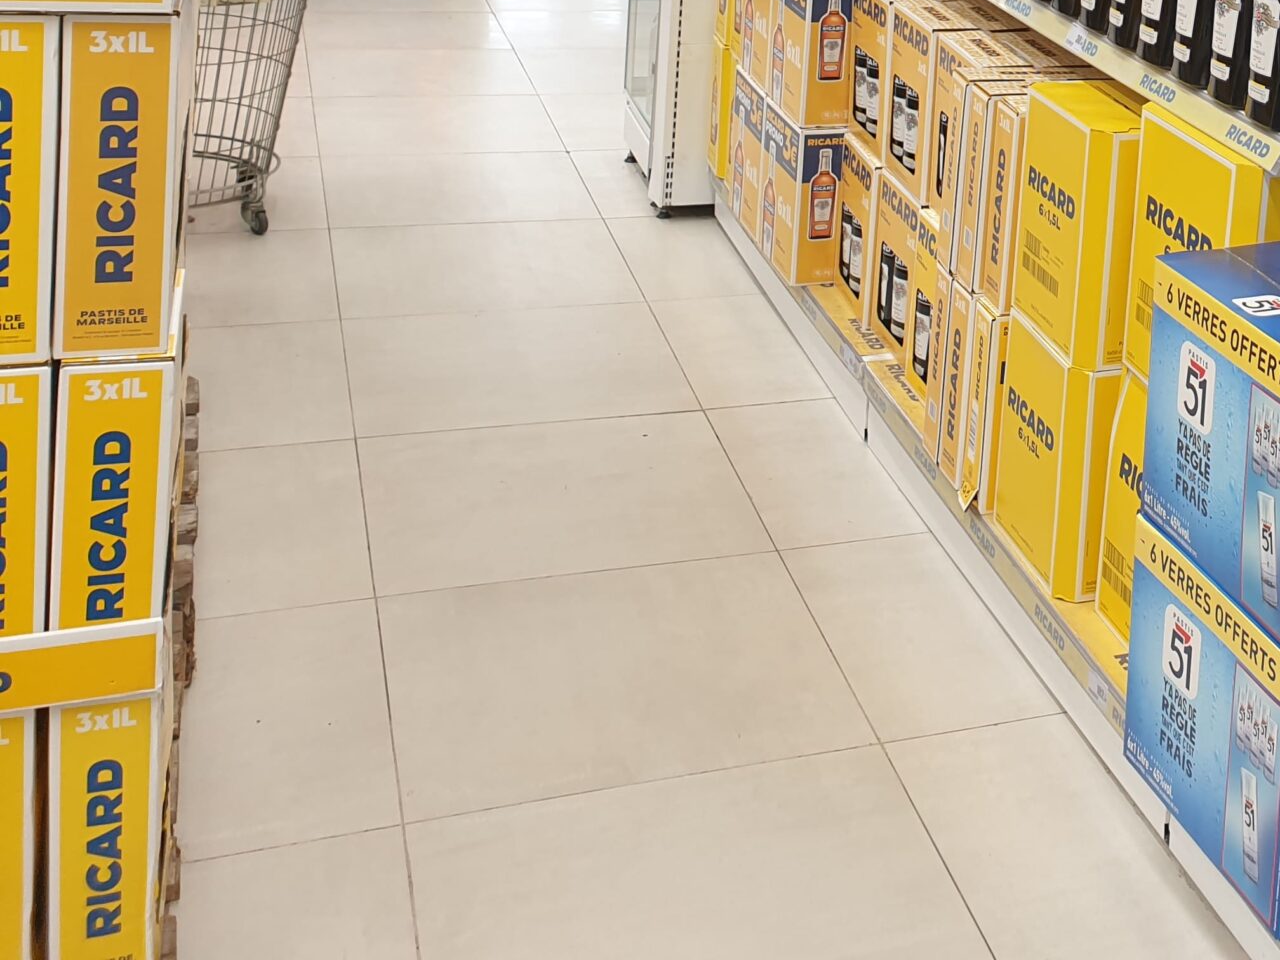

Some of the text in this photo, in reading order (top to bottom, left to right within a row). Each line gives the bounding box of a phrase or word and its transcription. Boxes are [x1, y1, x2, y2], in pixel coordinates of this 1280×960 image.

[89, 31, 155, 54] 3x1L
[893, 12, 929, 57] RICARD
[1139, 73, 1176, 104] RICARD
[765, 122, 784, 146] PROMO
[807, 138, 845, 147] RICARD
[1225, 123, 1271, 159] RICARD
[94, 86, 139, 284] RICARD
[843, 145, 872, 191] RICARD
[967, 121, 979, 207] RICARD
[882, 182, 919, 232] RICARD
[990, 148, 1006, 265] RICARD
[1027, 164, 1076, 220] RICARD
[76, 315, 148, 327] MARSEILLE
[80, 308, 145, 318] PASTIS DE
[1166, 282, 1174, 304] 6
[1177, 287, 1227, 343] VERRES
[83, 377, 148, 402] 3x1L
[947, 328, 962, 441] RICARD
[1183, 366, 1208, 426] 51
[1007, 386, 1055, 452] RICARD
[1189, 427, 1201, 453] PAS
[1203, 440, 1211, 461] DE
[86, 430, 132, 622] RICARD
[969, 520, 996, 559] RICARD
[1034, 603, 1065, 651] RICARD
[1150, 543, 1277, 677] 6 VERRES OFFERTS
[1167, 632, 1192, 692] 51
[75, 706, 137, 734] 3x1L
[86, 758, 124, 939] RICARD
